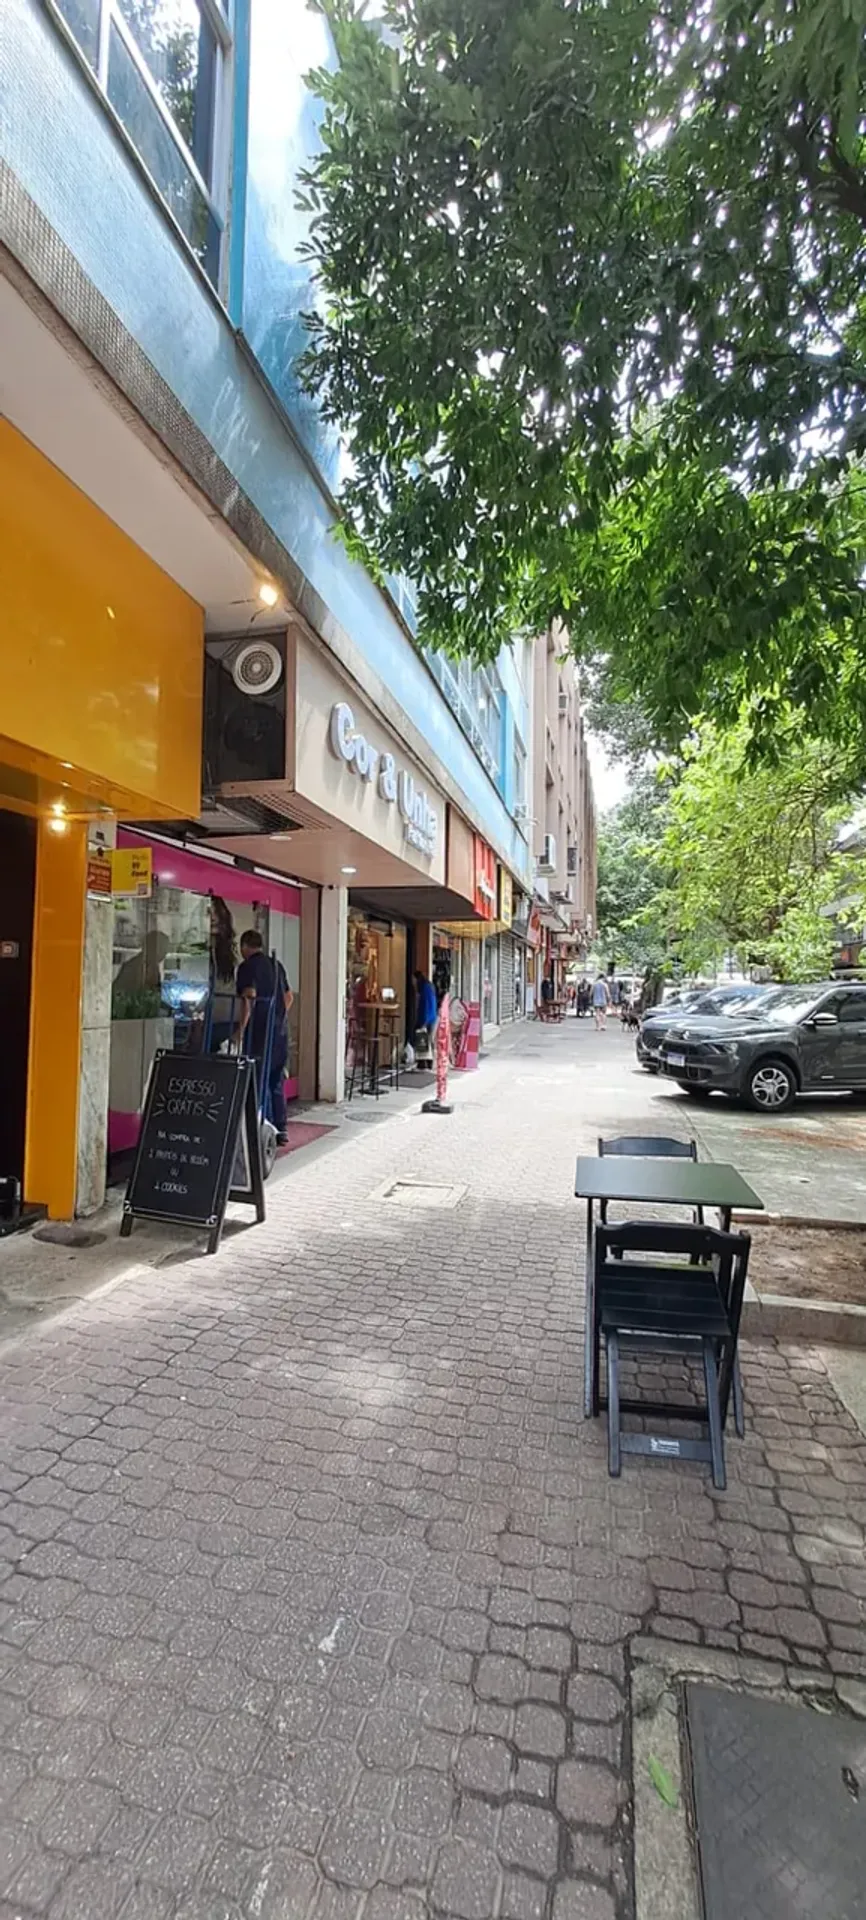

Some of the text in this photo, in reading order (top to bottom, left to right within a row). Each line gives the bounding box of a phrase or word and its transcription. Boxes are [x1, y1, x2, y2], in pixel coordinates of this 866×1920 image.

[330, 702, 378, 783] Cor
[378, 752, 397, 803] &
[168, 1077, 216, 1096] ESPRESSO
[167, 1096, 205, 1116] GRÁTIS
